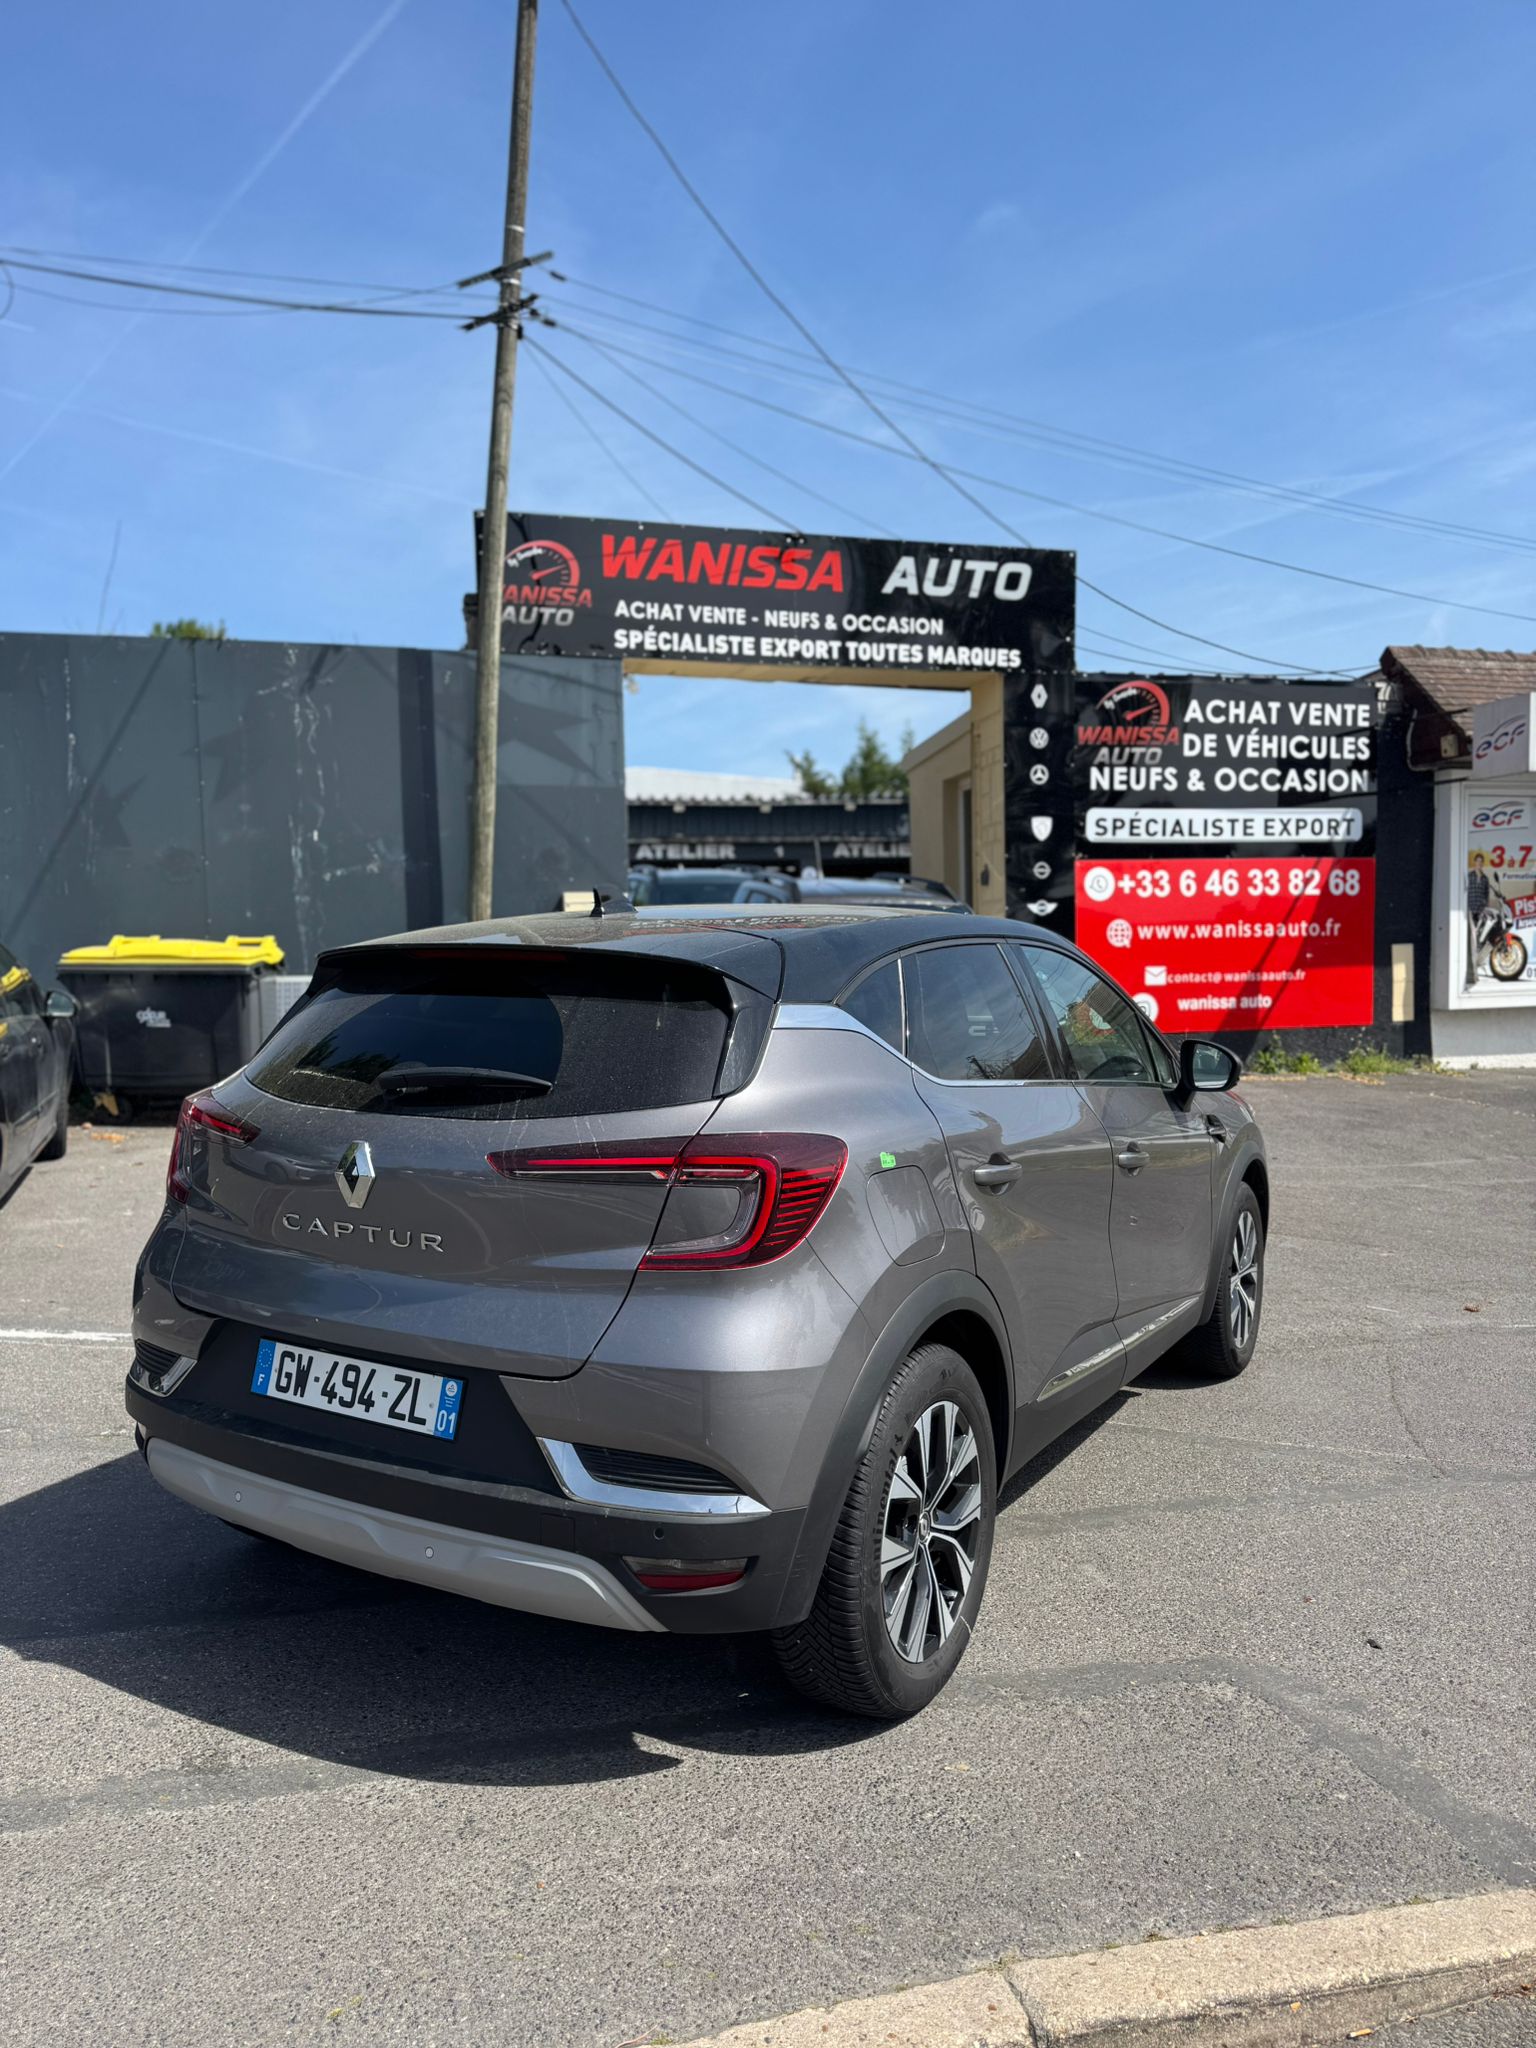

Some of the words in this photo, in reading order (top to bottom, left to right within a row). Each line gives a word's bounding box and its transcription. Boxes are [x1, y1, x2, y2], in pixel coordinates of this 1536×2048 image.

[602, 534, 843, 592] WANISSA
[881, 556, 1032, 601] AUTO
[502, 584, 592, 608] ANISSA
[502, 605, 574, 626] AUTO
[615, 600, 684, 622] ACHAT
[688, 604, 746, 626] VENTE
[764, 610, 820, 630] NEUFS
[824, 614, 838, 631] &
[842, 614, 944, 635] OCCASION
[614, 625, 755, 656] SPÉCIALISTE
[760, 638, 841, 661] EXPORT
[845, 641, 923, 663] TOUTES
[927, 645, 1021, 668] MARQUES
[1183, 699, 1281, 725] ACHAT
[1288, 702, 1370, 727] VENTE
[1077, 725, 1180, 747] WANISSA
[1183, 733, 1217, 757] DE
[1225, 728, 1370, 760] VÉHICULES
[1093, 746, 1162, 765] AUTO
[1090, 766, 1178, 791] NEUFS
[1187, 768, 1205, 791] &
[1214, 767, 1368, 792] OCCASION
[1095, 812, 1255, 837] SPÉCIALISTE
[1263, 818, 1355, 837] EXPORT
[635, 843, 736, 861] ATELIER
[833, 842, 912, 859] ATELIE
[1490, 845, 1505, 868] 3
[1519, 845, 1534, 868] 7
[1117, 869, 1170, 898] +33
[1179, 869, 1197, 897] 6
[1204, 869, 1239, 896] 46
[1247, 868, 1281, 896] 33
[1288, 868, 1321, 896] 82
[1328, 868, 1360, 896] 68
[1137, 918, 1341, 940] www.wanissaauto.fr
[1177, 994, 1236, 1011] wanissa
[1240, 994, 1272, 1009] auto
[283, 1214, 443, 1252] CAPTUR
[257, 1373, 265, 1385] F
[275, 1350, 427, 1426] GW-494-ZL
[437, 1409, 456, 1434] 01
